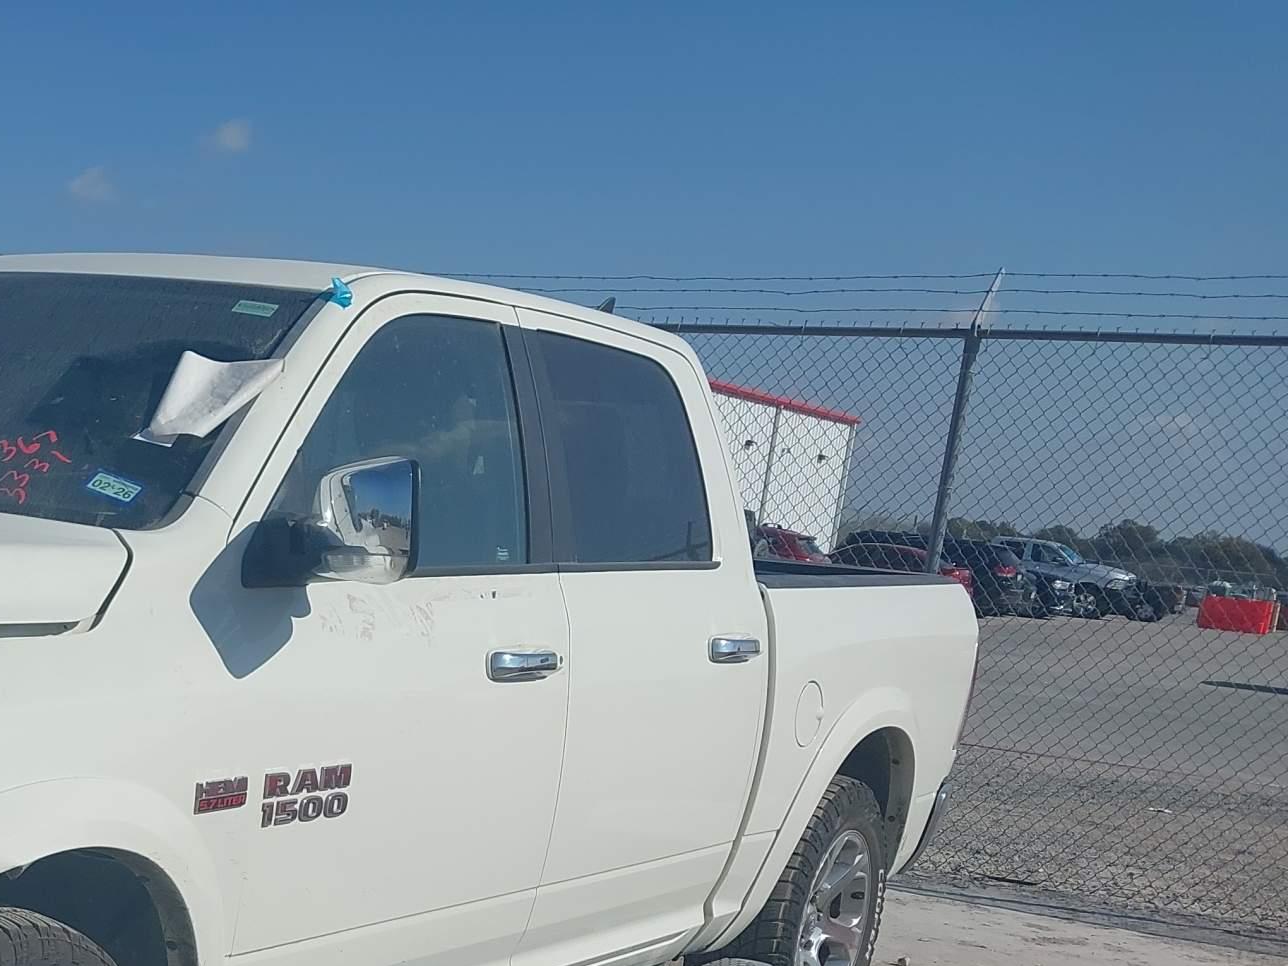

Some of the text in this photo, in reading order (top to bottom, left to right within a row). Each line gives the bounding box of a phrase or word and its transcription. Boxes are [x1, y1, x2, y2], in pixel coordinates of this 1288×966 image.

[263, 764, 353, 799] RAM
[261, 792, 349, 828] 1500
[865, 868, 885, 961] COO
